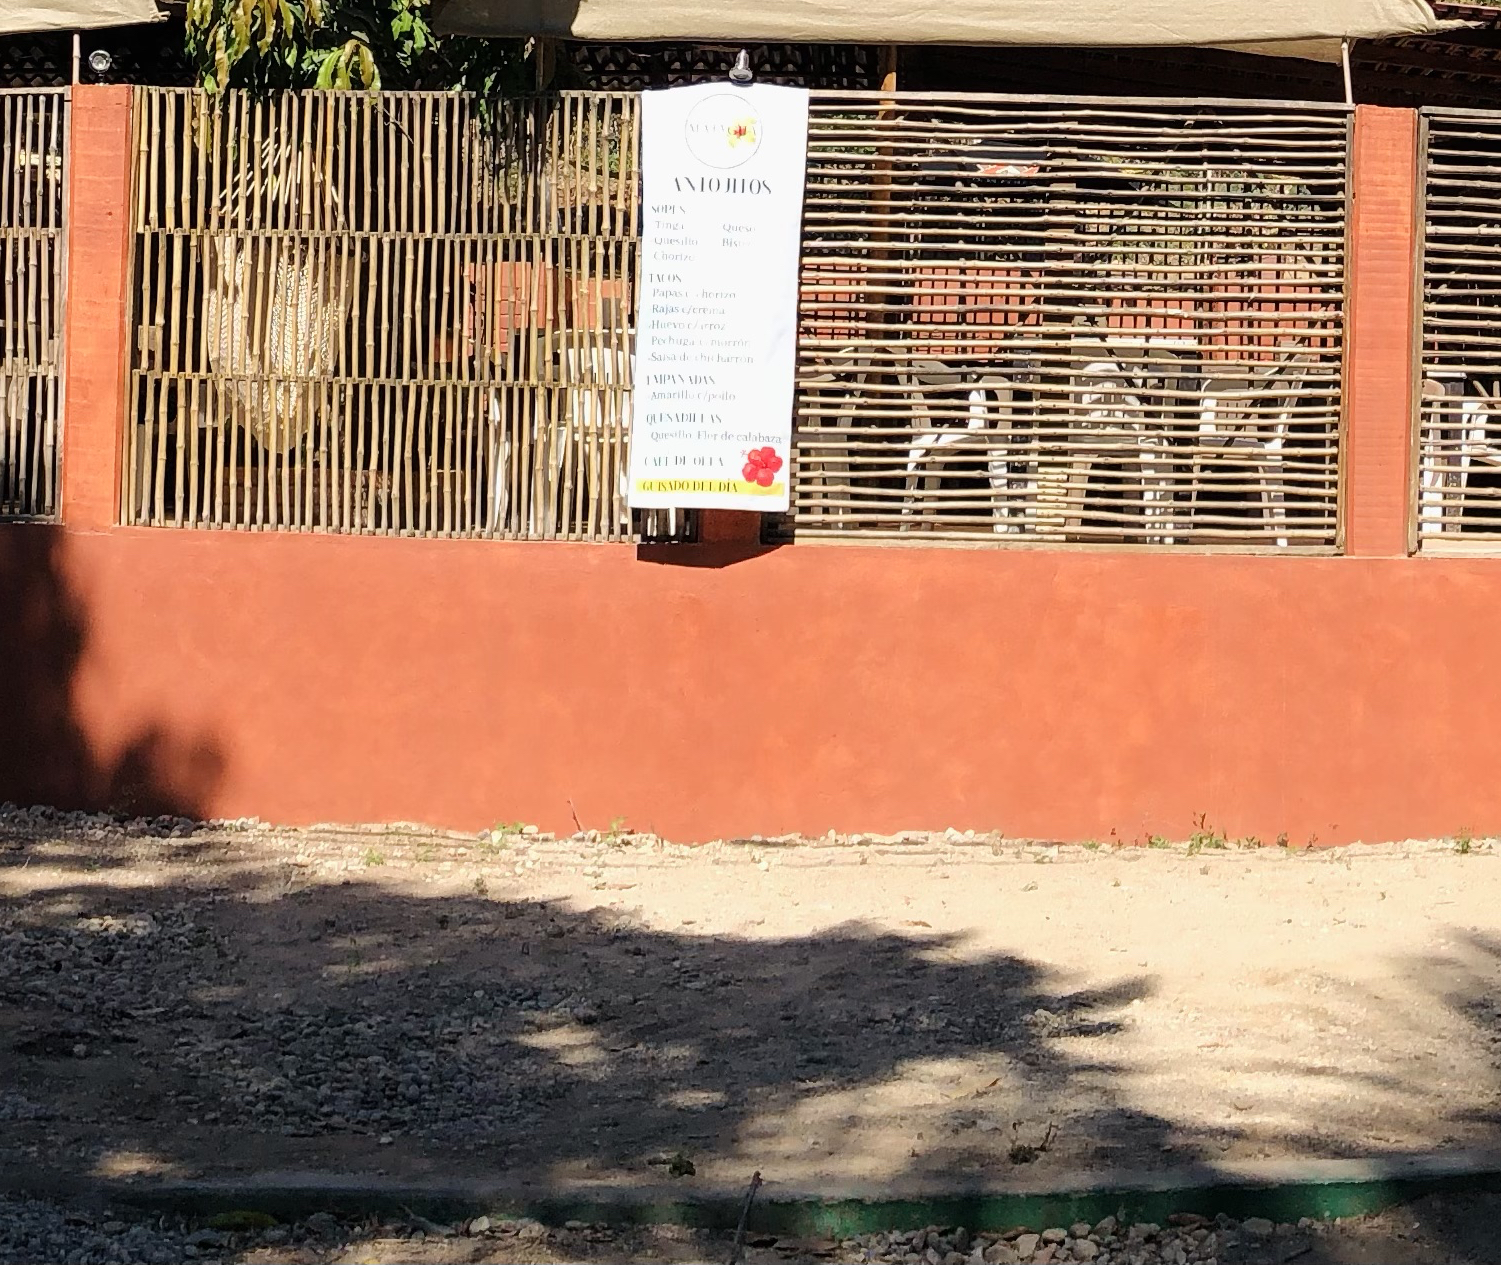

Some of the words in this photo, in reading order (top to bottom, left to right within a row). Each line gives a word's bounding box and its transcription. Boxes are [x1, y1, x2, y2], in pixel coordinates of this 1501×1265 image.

[674, 176, 772, 195] ANTOJITOS
[652, 287, 683, 300] Papas
[651, 303, 680, 315] Rajas
[720, 431, 734, 441] de
[736, 432, 783, 444] calabaza
[642, 480, 690, 493] GUISADO
[692, 481, 717, 493] DEL
